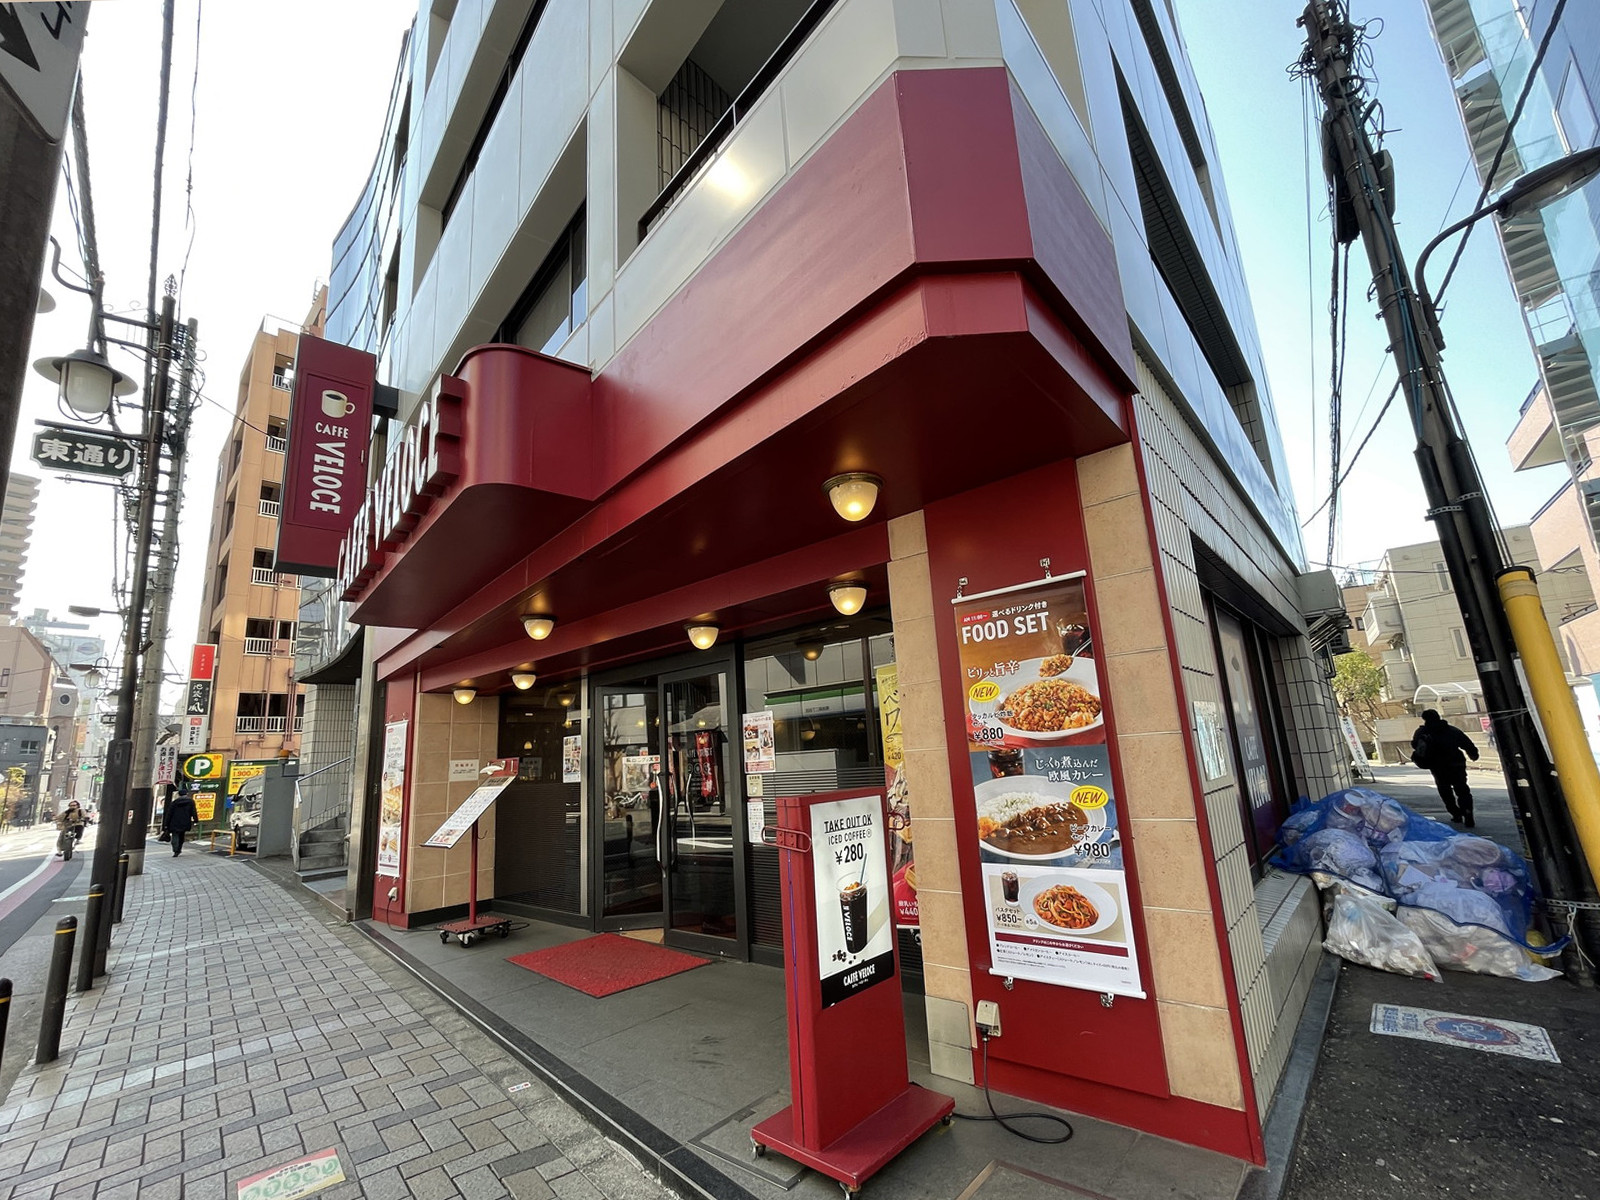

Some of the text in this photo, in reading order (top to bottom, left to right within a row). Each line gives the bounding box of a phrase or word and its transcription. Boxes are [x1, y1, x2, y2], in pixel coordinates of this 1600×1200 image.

[38, 438, 130, 470] 東通り
[373, 374, 443, 551] VELOCE
[309, 442, 346, 514] VELOCE
[961, 611, 1049, 645] FOOD SET
[967, 660, 1020, 679] ピリッと旨辛
[972, 686, 995, 699] NEW
[974, 727, 1004, 740] ¥880
[193, 759, 211, 776] P
[1035, 756, 1099, 770] じっくり煮込んだ
[1047, 770, 1104, 782] 欧風カレー
[1074, 791, 1104, 804] NEW
[824, 813, 873, 833] TAKE OUT OK
[828, 834, 843, 845] ICED
[835, 842, 864, 865] ¥280
[1074, 842, 1110, 858] ¥980
